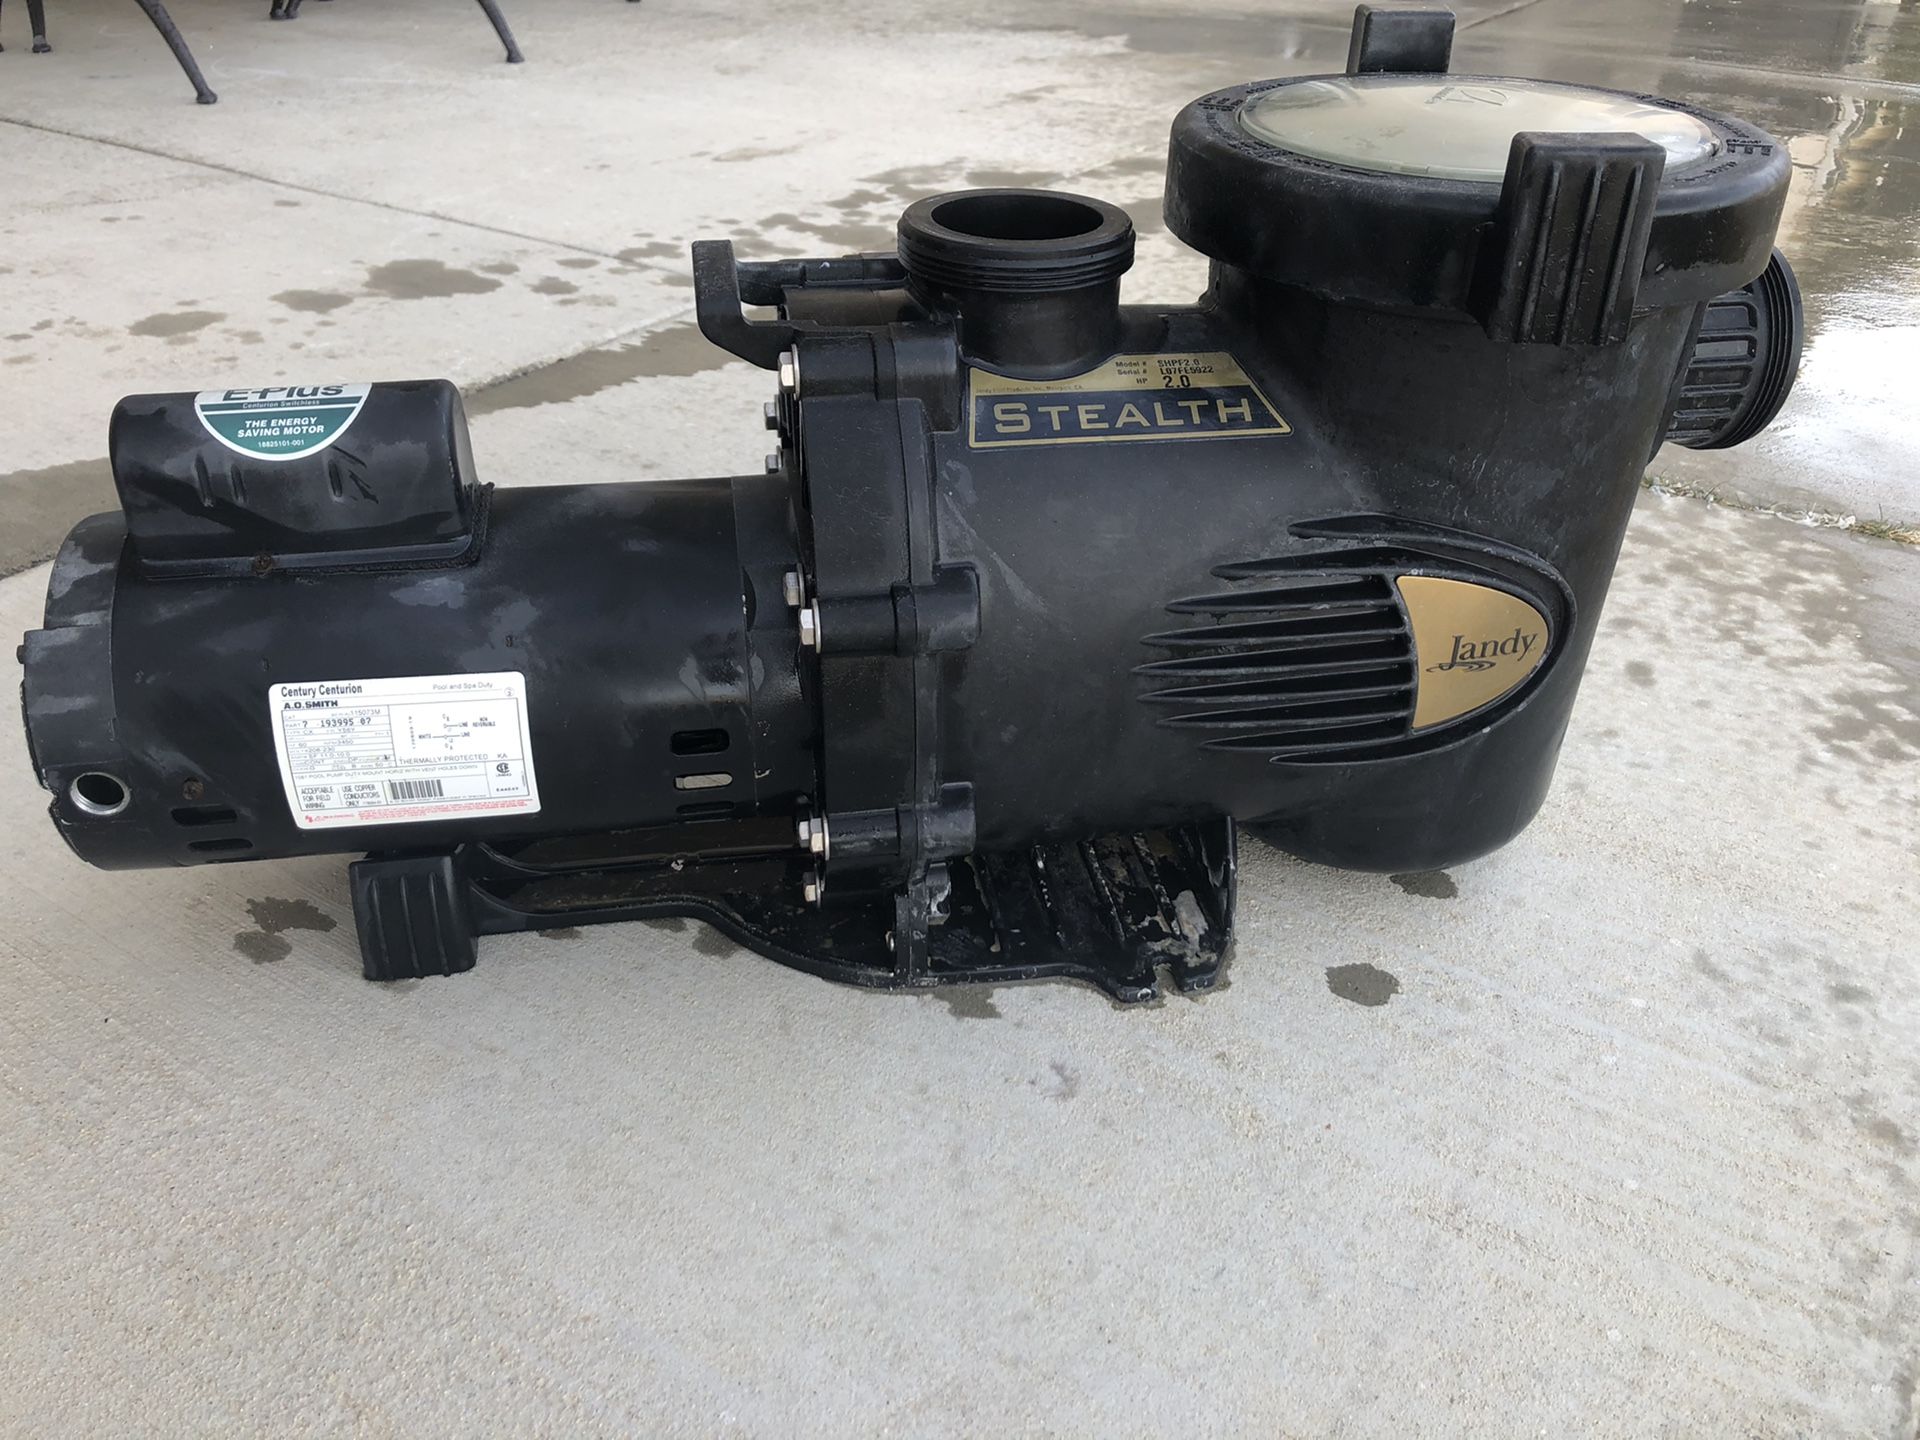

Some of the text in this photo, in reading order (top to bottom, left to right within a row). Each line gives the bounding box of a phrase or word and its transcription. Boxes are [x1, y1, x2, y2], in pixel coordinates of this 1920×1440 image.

[1157, 358, 1200, 367] SHPF2.0
[1160, 365, 1214, 375] L07FE5922
[1162, 374, 1191, 388] 2.0
[243, 399, 320, 409] Centurion Switchless
[993, 398, 1253, 433] STEALTH
[245, 417, 317, 428] THE ENERGY
[237, 425, 324, 438] SAVING MOTOR
[1440, 627, 1538, 671] Jandy
[478, 681, 493, 689] Duty
[281, 683, 363, 698] Century Centurion
[320, 718, 354, 728] 193995
[399, 755, 442, 765] THERMALLY
[444, 753, 488, 762] PROTECTED
[342, 784, 376, 793] USE COPPER
[343, 792, 380, 800] CONDUCTORS
